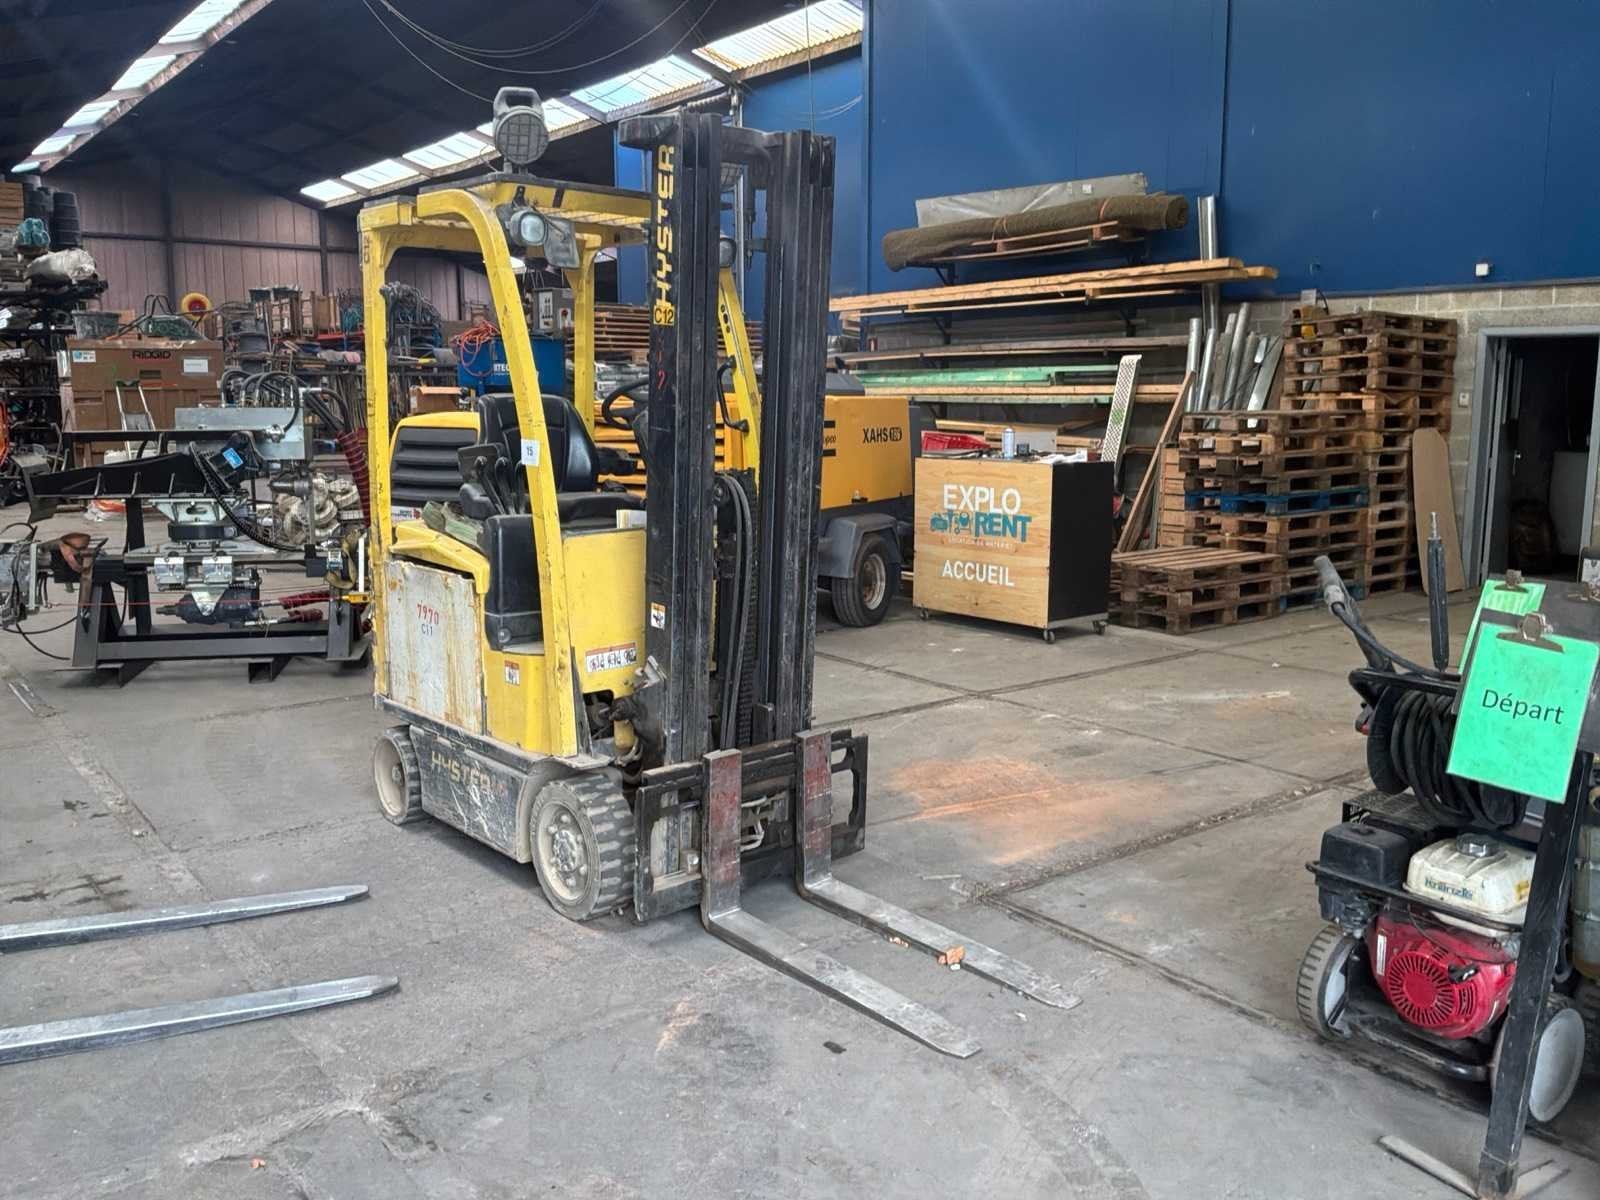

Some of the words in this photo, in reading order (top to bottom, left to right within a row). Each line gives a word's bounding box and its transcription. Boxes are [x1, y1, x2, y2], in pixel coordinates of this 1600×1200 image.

[656, 144, 674, 306] HYSTER
[654, 307, 674, 324] C12
[132, 350, 171, 359] RIDGID
[863, 427, 888, 443] XAHS
[526, 446, 533, 456] 15
[943, 483, 1022, 514] EXPLO
[974, 511, 1033, 543] RENT
[942, 559, 1016, 587] ACCUEIL
[416, 603, 439, 625] 7970
[1482, 688, 1565, 725] Départ
